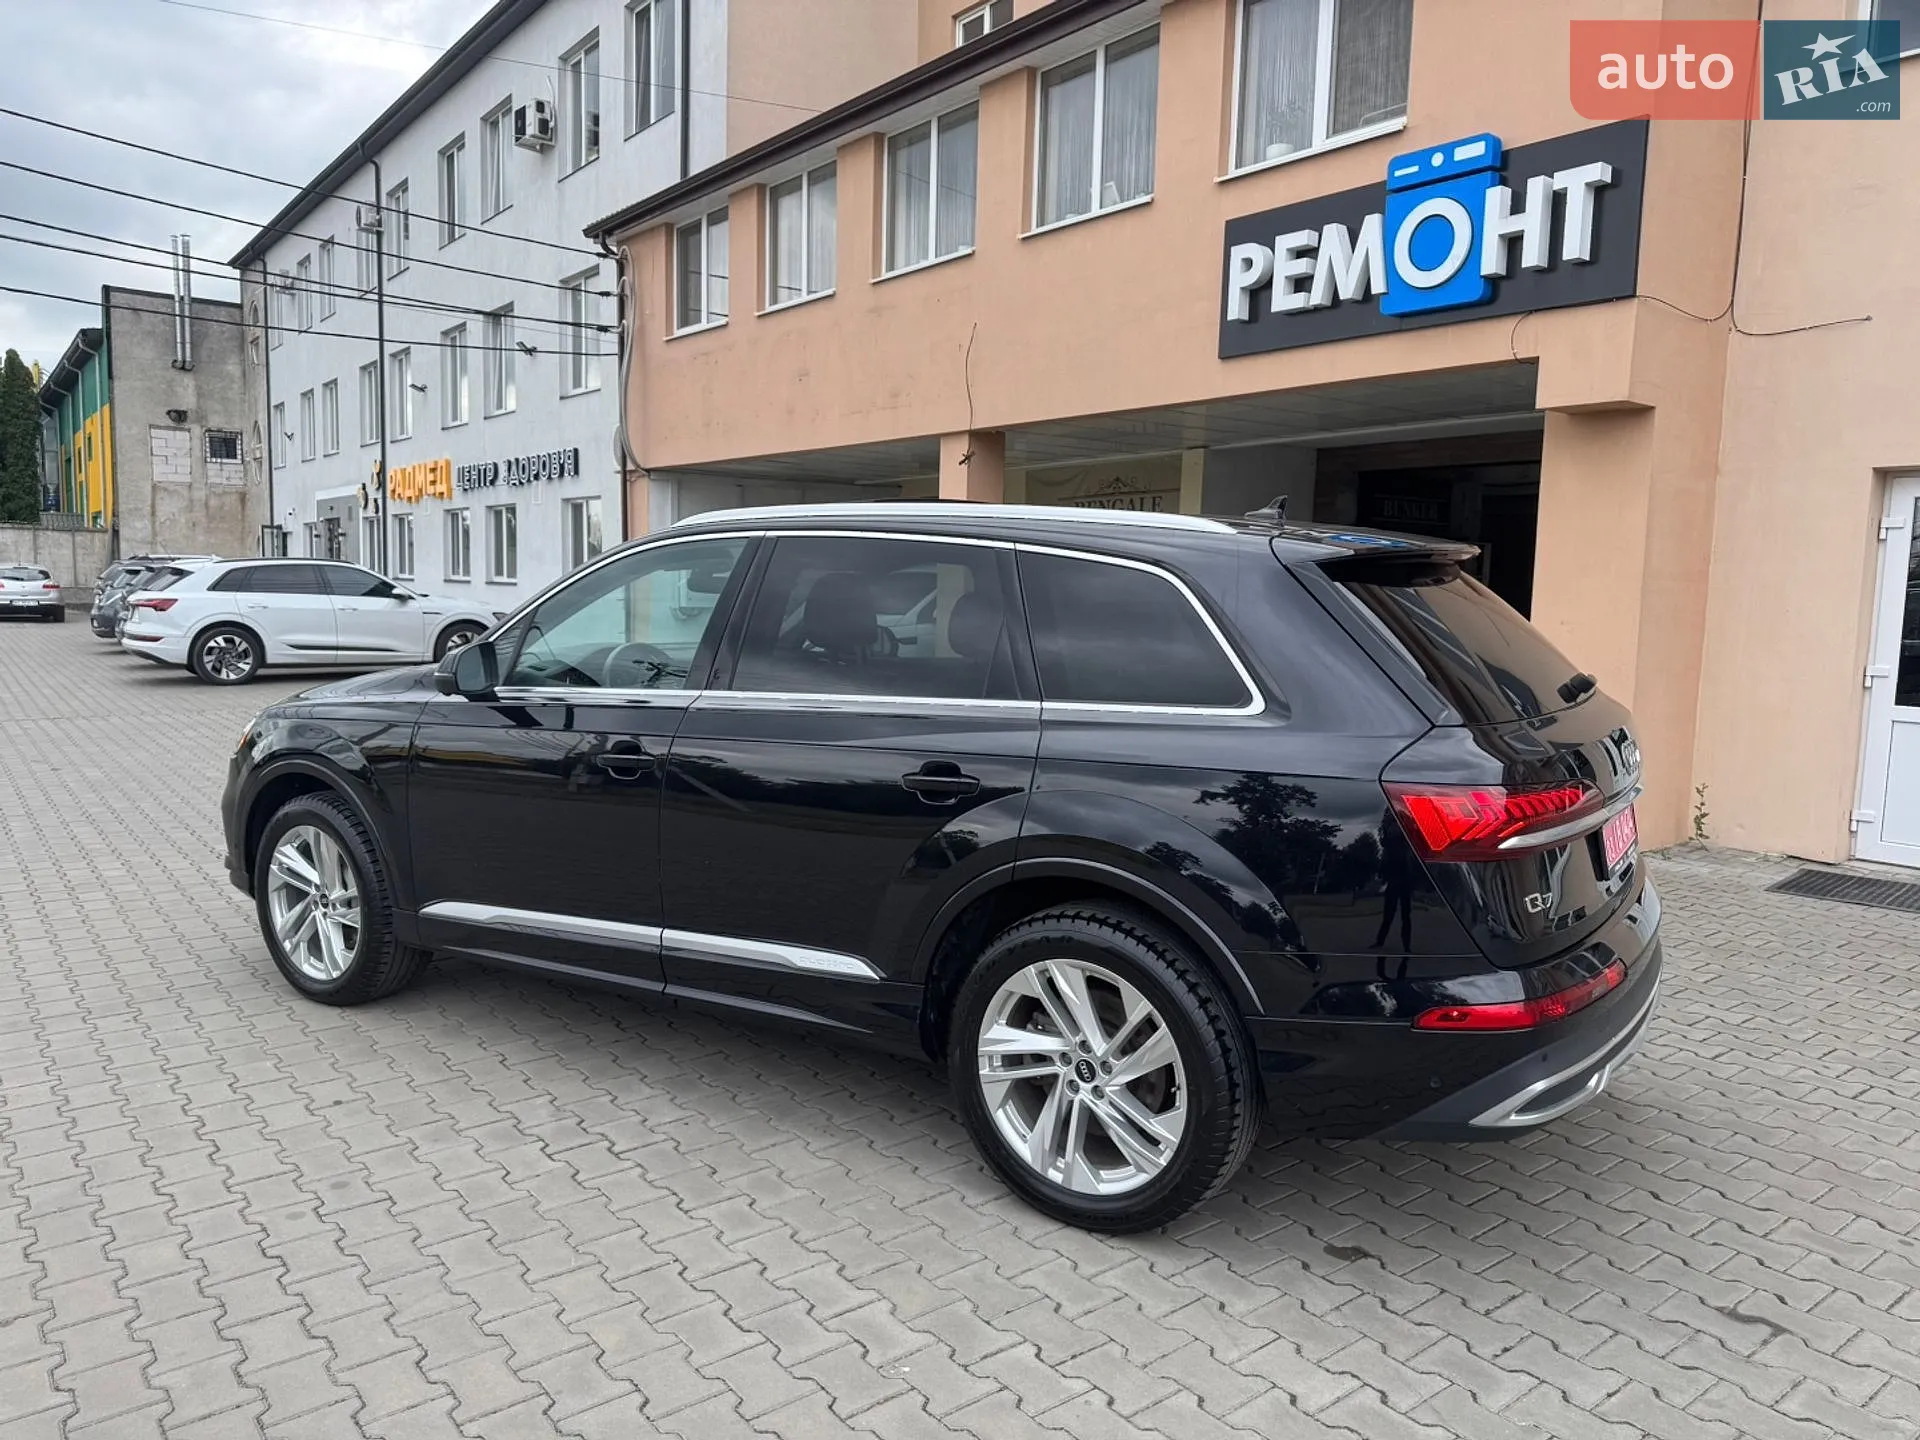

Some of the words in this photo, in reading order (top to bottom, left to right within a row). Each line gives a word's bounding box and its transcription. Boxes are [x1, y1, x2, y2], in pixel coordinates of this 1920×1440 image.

[1227, 161, 1612, 322] РЕМОНТ
[388, 457, 452, 504] РАДМЕД
[456, 461, 500, 491] ЦЕНТР
[502, 447, 580, 487] ЗДОРОВ'Я
[1525, 892, 1553, 913] Q7
